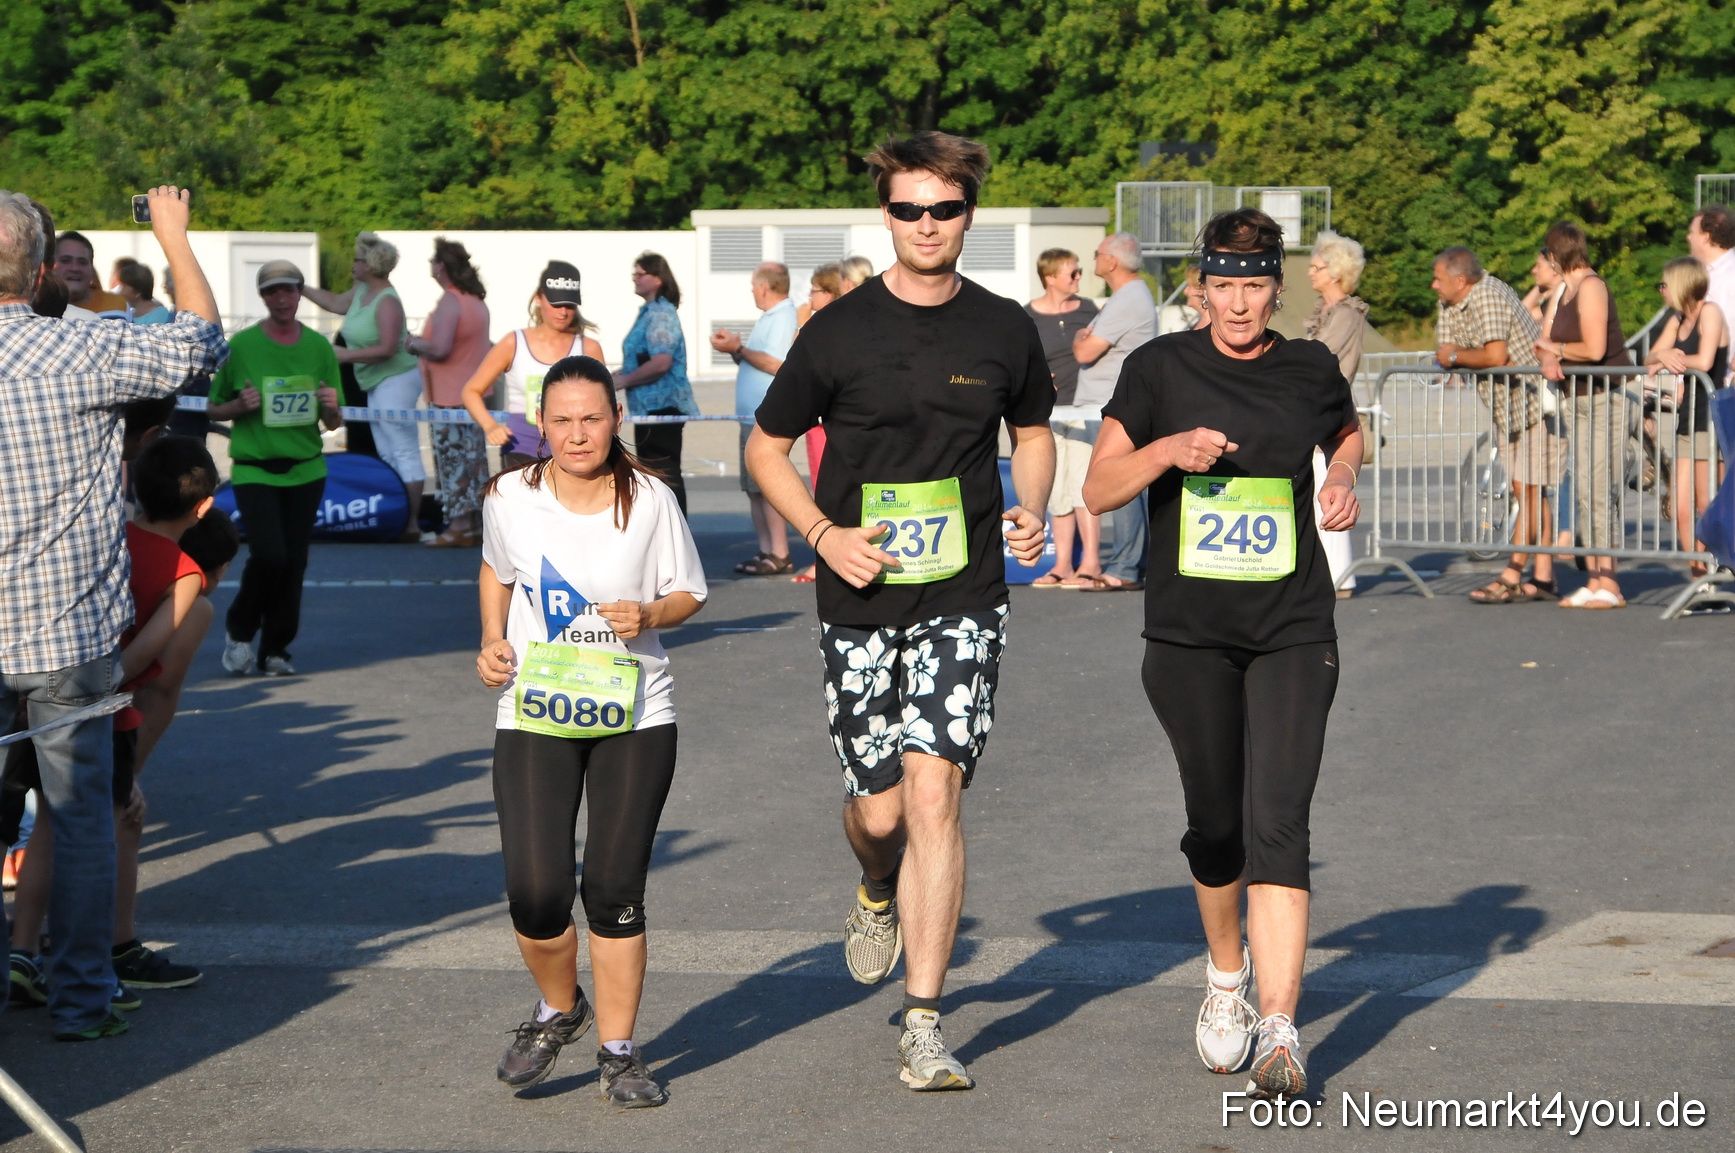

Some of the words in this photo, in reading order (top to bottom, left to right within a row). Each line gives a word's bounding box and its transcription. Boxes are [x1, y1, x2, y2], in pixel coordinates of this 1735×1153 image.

[950, 375, 987, 385] Johannes
[272, 393, 309, 413] 572
[875, 516, 949, 558] 237
[1196, 513, 1278, 554] 249
[1205, 563, 1245, 571] Goldschmiede
[557, 625, 617, 643] Team
[532, 647, 560, 659] 2014
[521, 688, 626, 728] 5080
